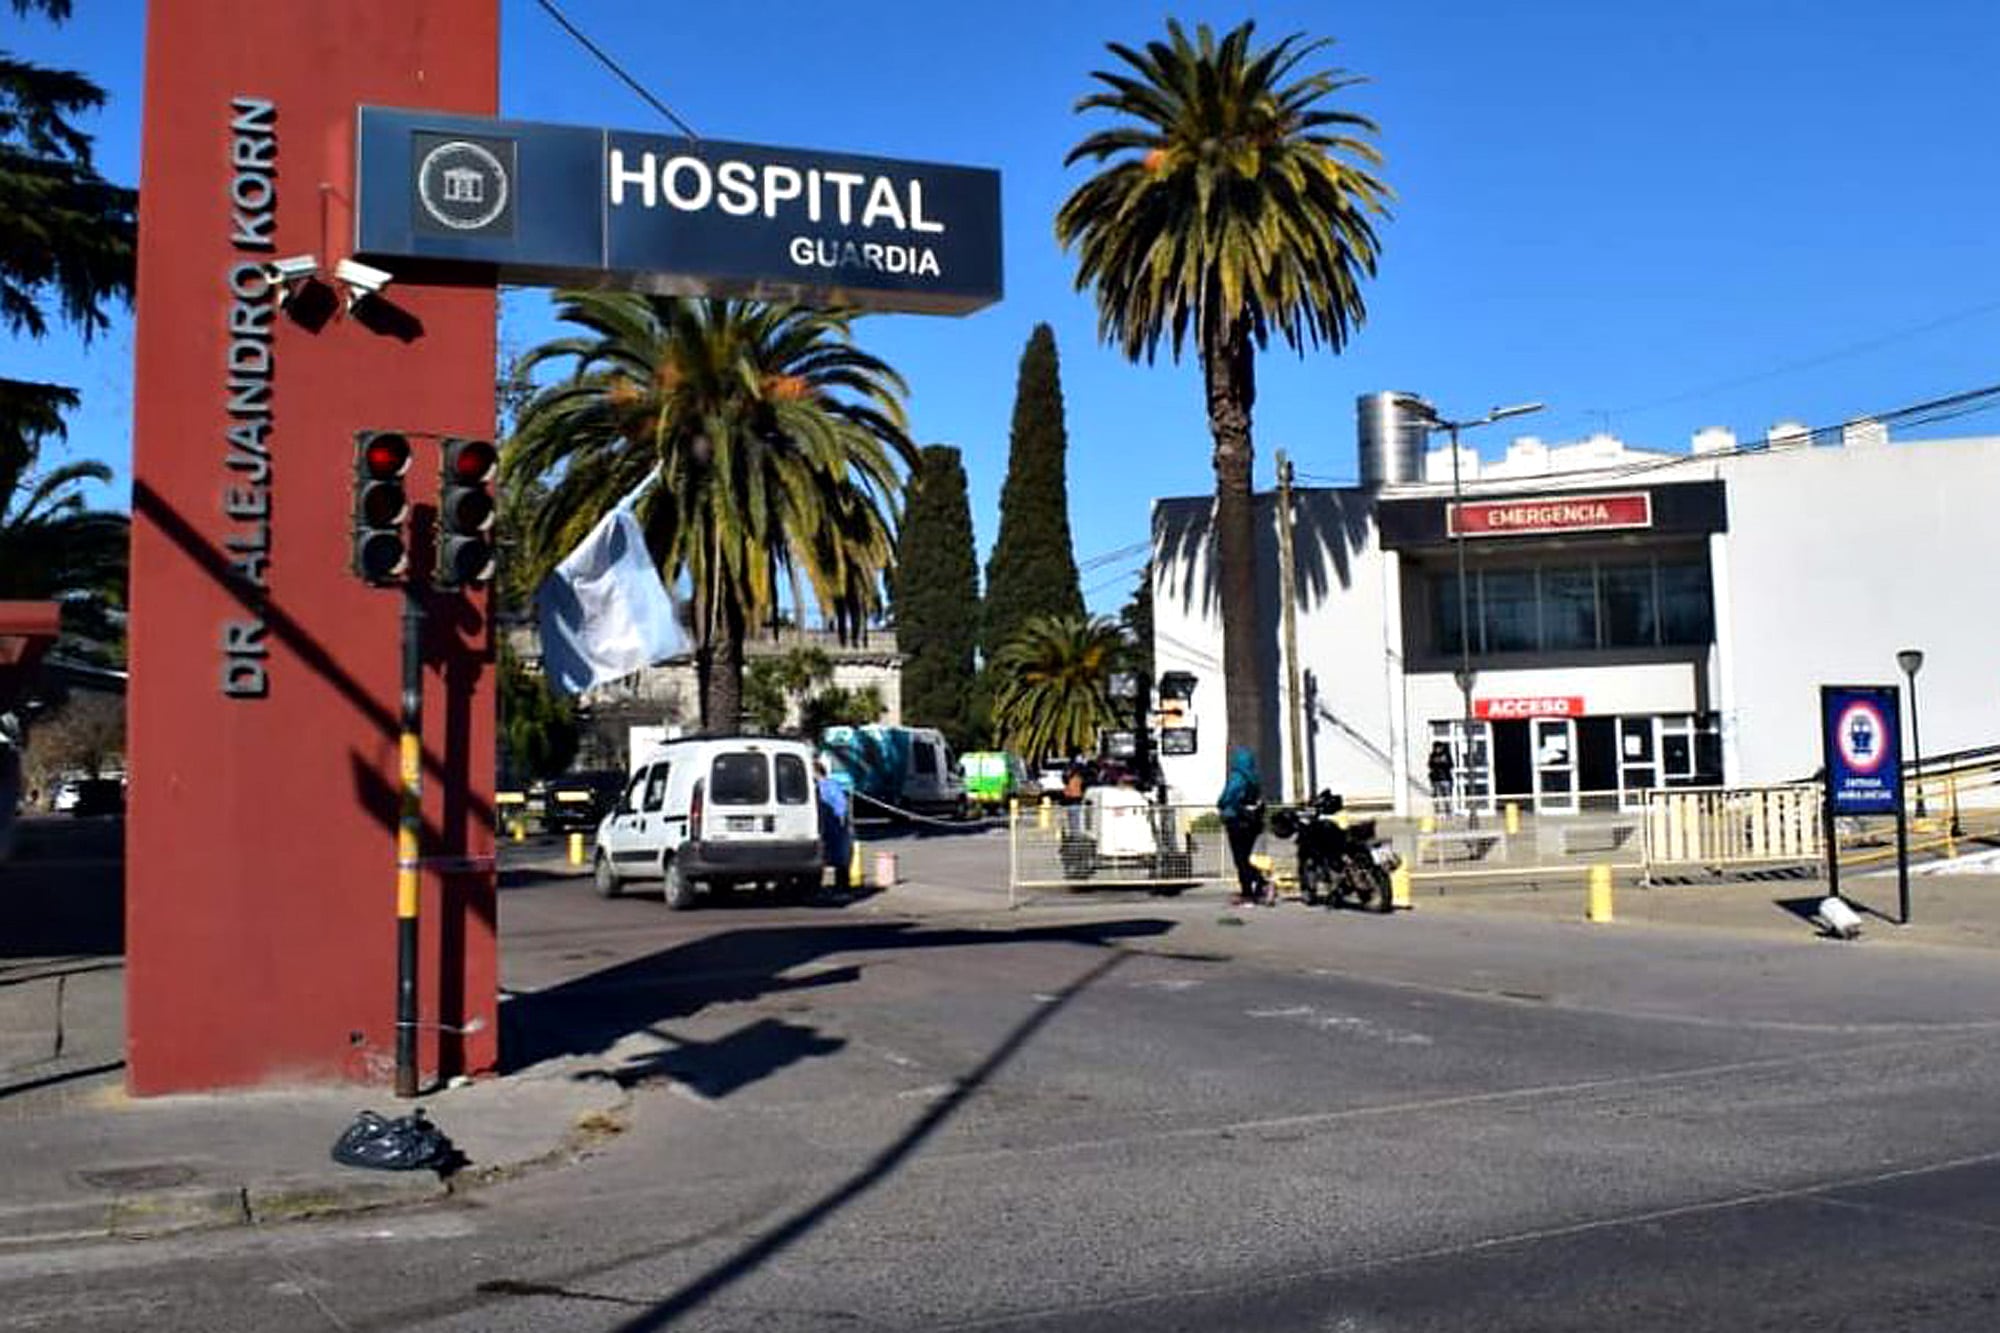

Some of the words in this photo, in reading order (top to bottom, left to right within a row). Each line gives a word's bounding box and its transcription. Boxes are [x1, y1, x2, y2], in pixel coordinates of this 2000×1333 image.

[229, 95, 275, 249] KORN
[610, 149, 945, 233] HOSPITAL
[789, 236, 941, 277] GUARDIA
[226, 262, 273, 589] ALEJANDRO
[1488, 504, 1609, 526] EMERGENCIA
[224, 619, 267, 698] DR
[1488, 699, 1569, 718] ACCESO
